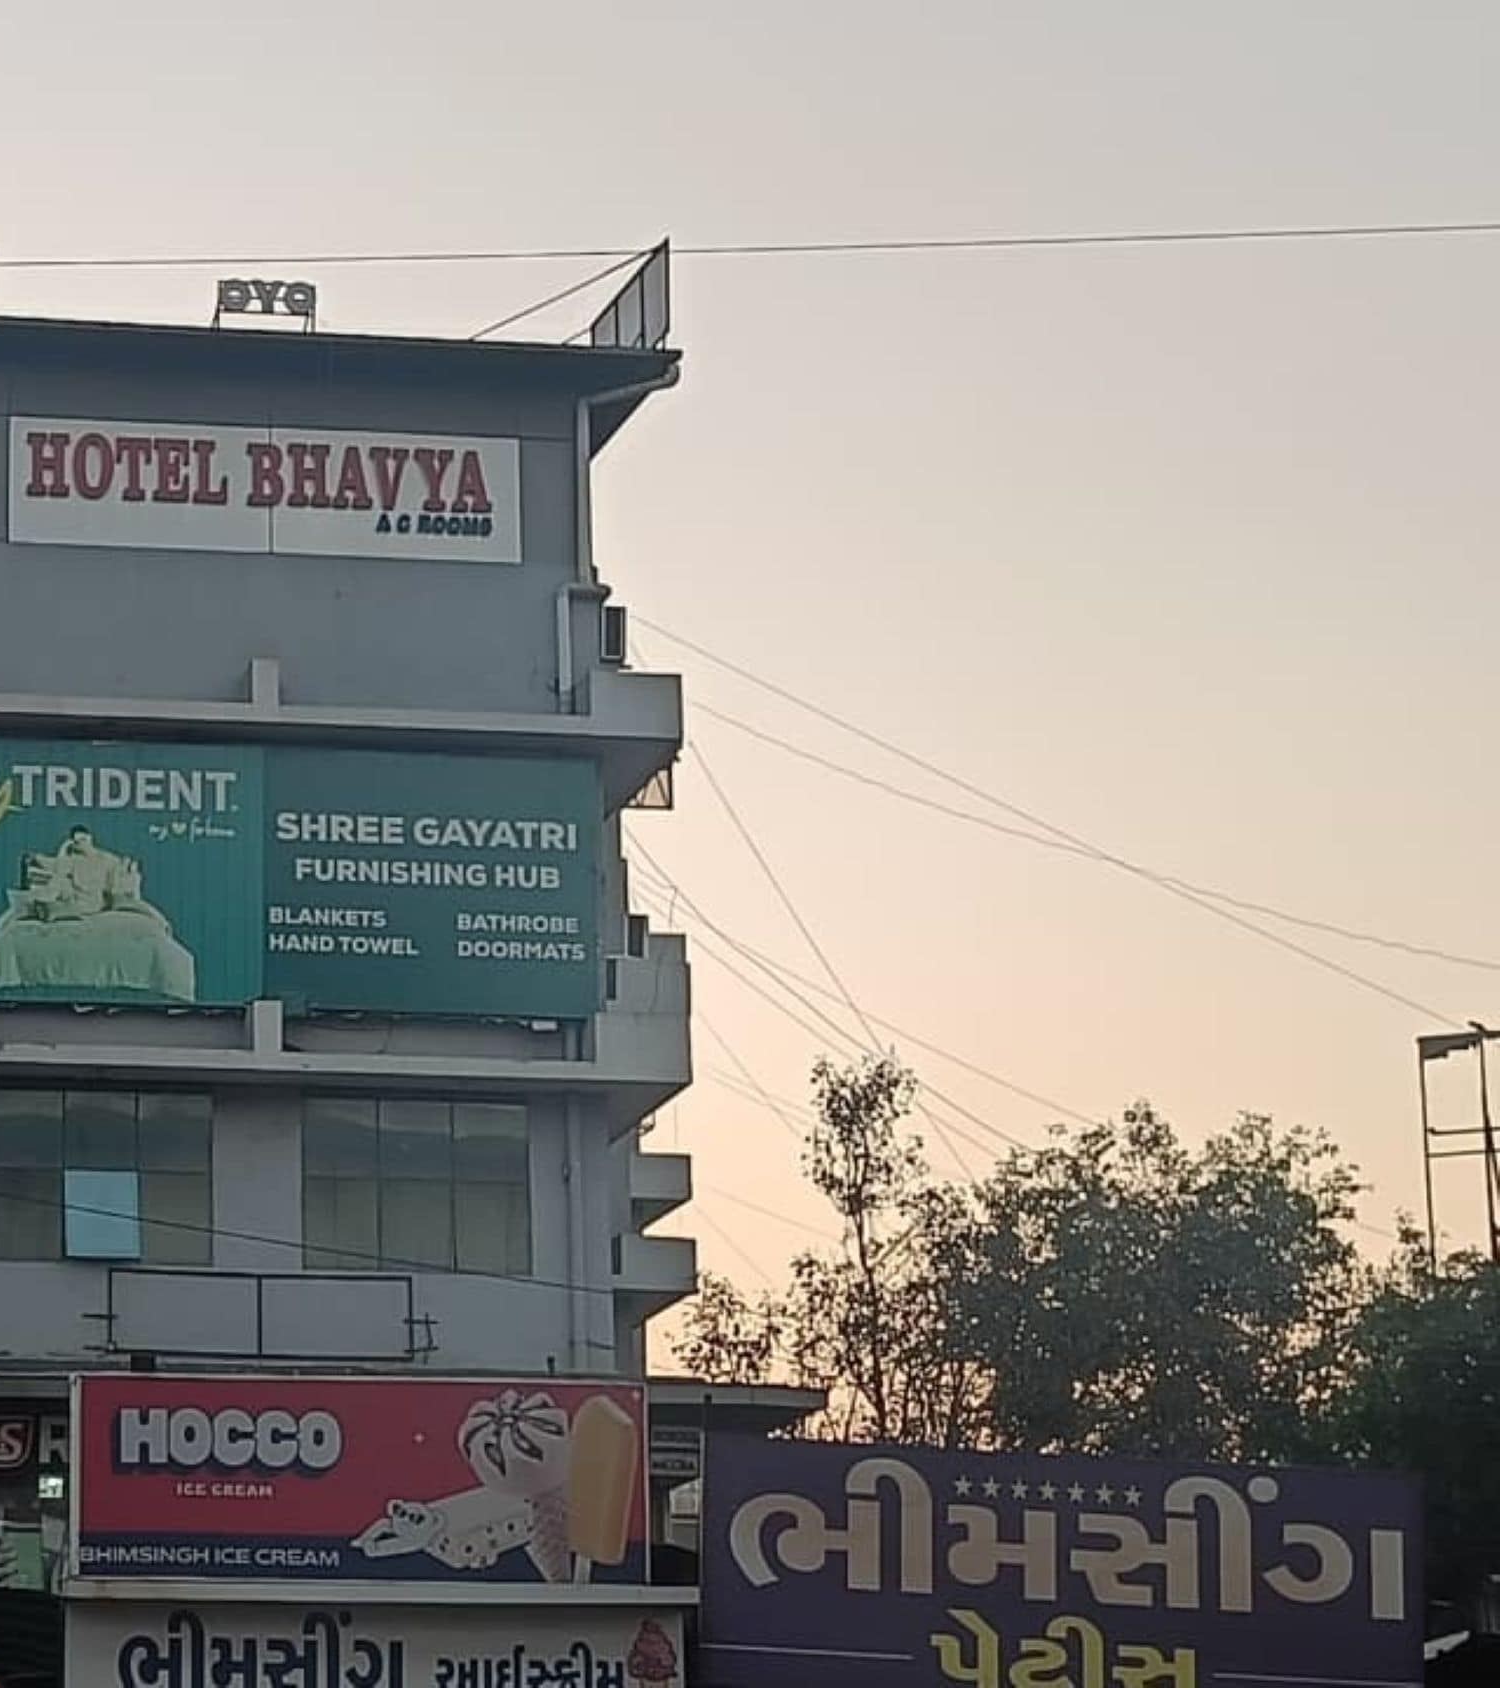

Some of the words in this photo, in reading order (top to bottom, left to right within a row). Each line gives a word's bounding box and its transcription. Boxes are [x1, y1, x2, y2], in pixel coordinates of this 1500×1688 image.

[26, 432, 228, 506] HOTEL
[246, 442, 493, 513] BHAVYA
[376, 513, 392, 533] A
[417, 513, 492, 536] ROOMS
[276, 812, 405, 845] SHREE
[413, 818, 577, 851] GAYATRI
[295, 858, 487, 887] FURNISHING
[495, 865, 561, 889] HUB
[268, 906, 387, 929] BLANKETS
[457, 913, 580, 934] BATHROBE
[268, 934, 335, 952] HAND
[337, 936, 420, 956] TOWEL
[457, 941, 586, 961] DOORMATS
[115, 1406, 343, 1474] HOCCO
[176, 1482, 207, 1497] ICE
[211, 1483, 274, 1498] CREAM
[729, 1456, 1406, 1621] ભીમસીંગ
[80, 1545, 210, 1565] BHIMSINGH
[214, 1548, 252, 1565] ICE
[254, 1549, 341, 1568] CREAM
